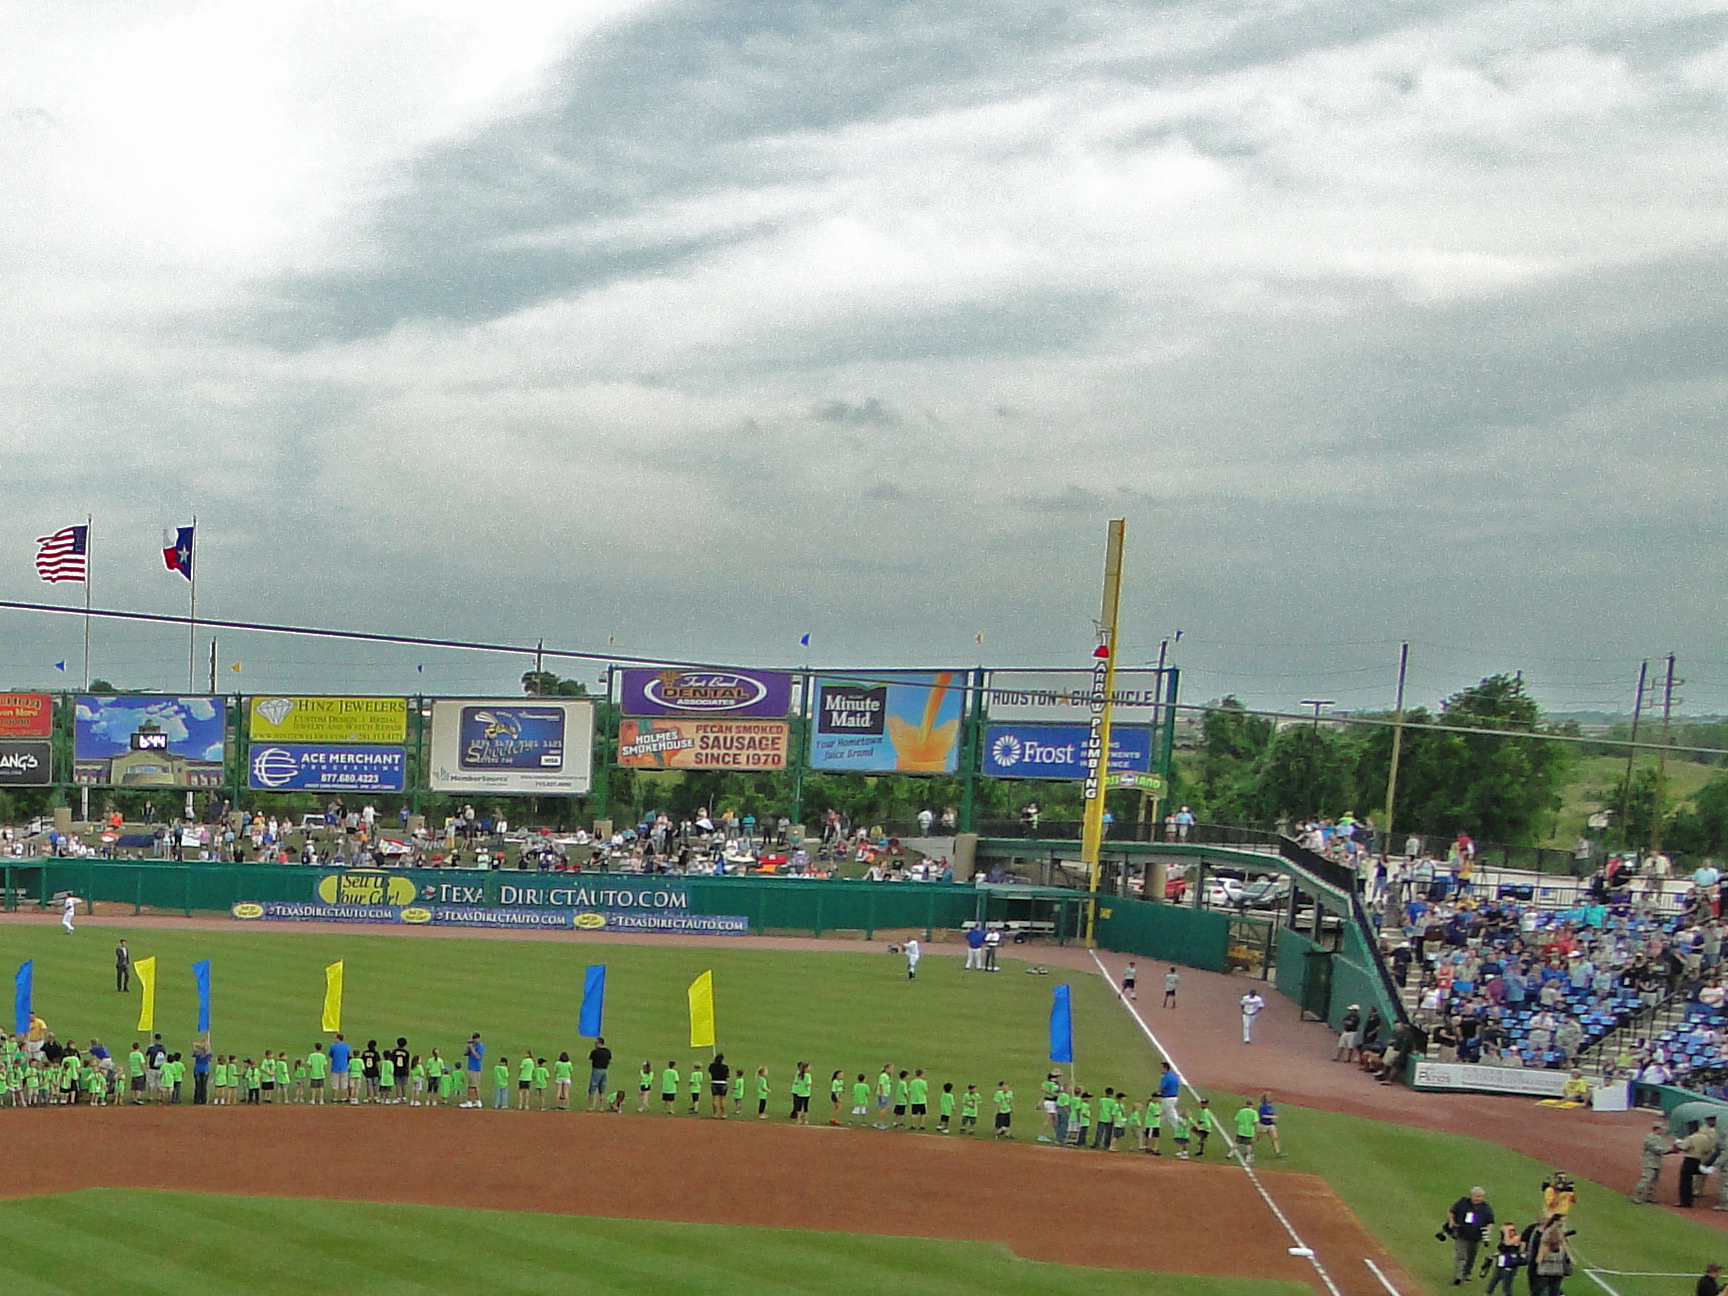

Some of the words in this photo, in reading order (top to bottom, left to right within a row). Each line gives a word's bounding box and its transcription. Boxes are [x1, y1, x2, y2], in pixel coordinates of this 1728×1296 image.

[663, 688, 749, 698] DENTAL
[992, 691, 1057, 706] HOUSTON
[298, 700, 334, 712] HINZ
[338, 701, 405, 714] JEWELERS
[825, 695, 880, 711] Minute
[16, 708, 38, 717] More
[831, 711, 871, 727] Maid
[696, 725, 732, 734] PECAN
[735, 725, 783, 734] SMOKED
[636, 732, 677, 744] HOLMES
[699, 736, 781, 750] SAUSAGE
[816, 740, 835, 749] Your
[837, 737, 883, 747] Hometown
[622, 739, 694, 755] SMOKEHOUSE
[1023, 741, 1075, 763] Frost
[301, 753, 326, 764] ACE
[330, 754, 401, 764] MERCHANT
[694, 753, 741, 765] SINCE
[745, 754, 781, 765] 1970
[824, 751, 844, 761] Juice
[847, 748, 873, 758] Brand
[1085, 718, 1102, 798] PLUMBING
[343, 876, 368, 888] Sell
